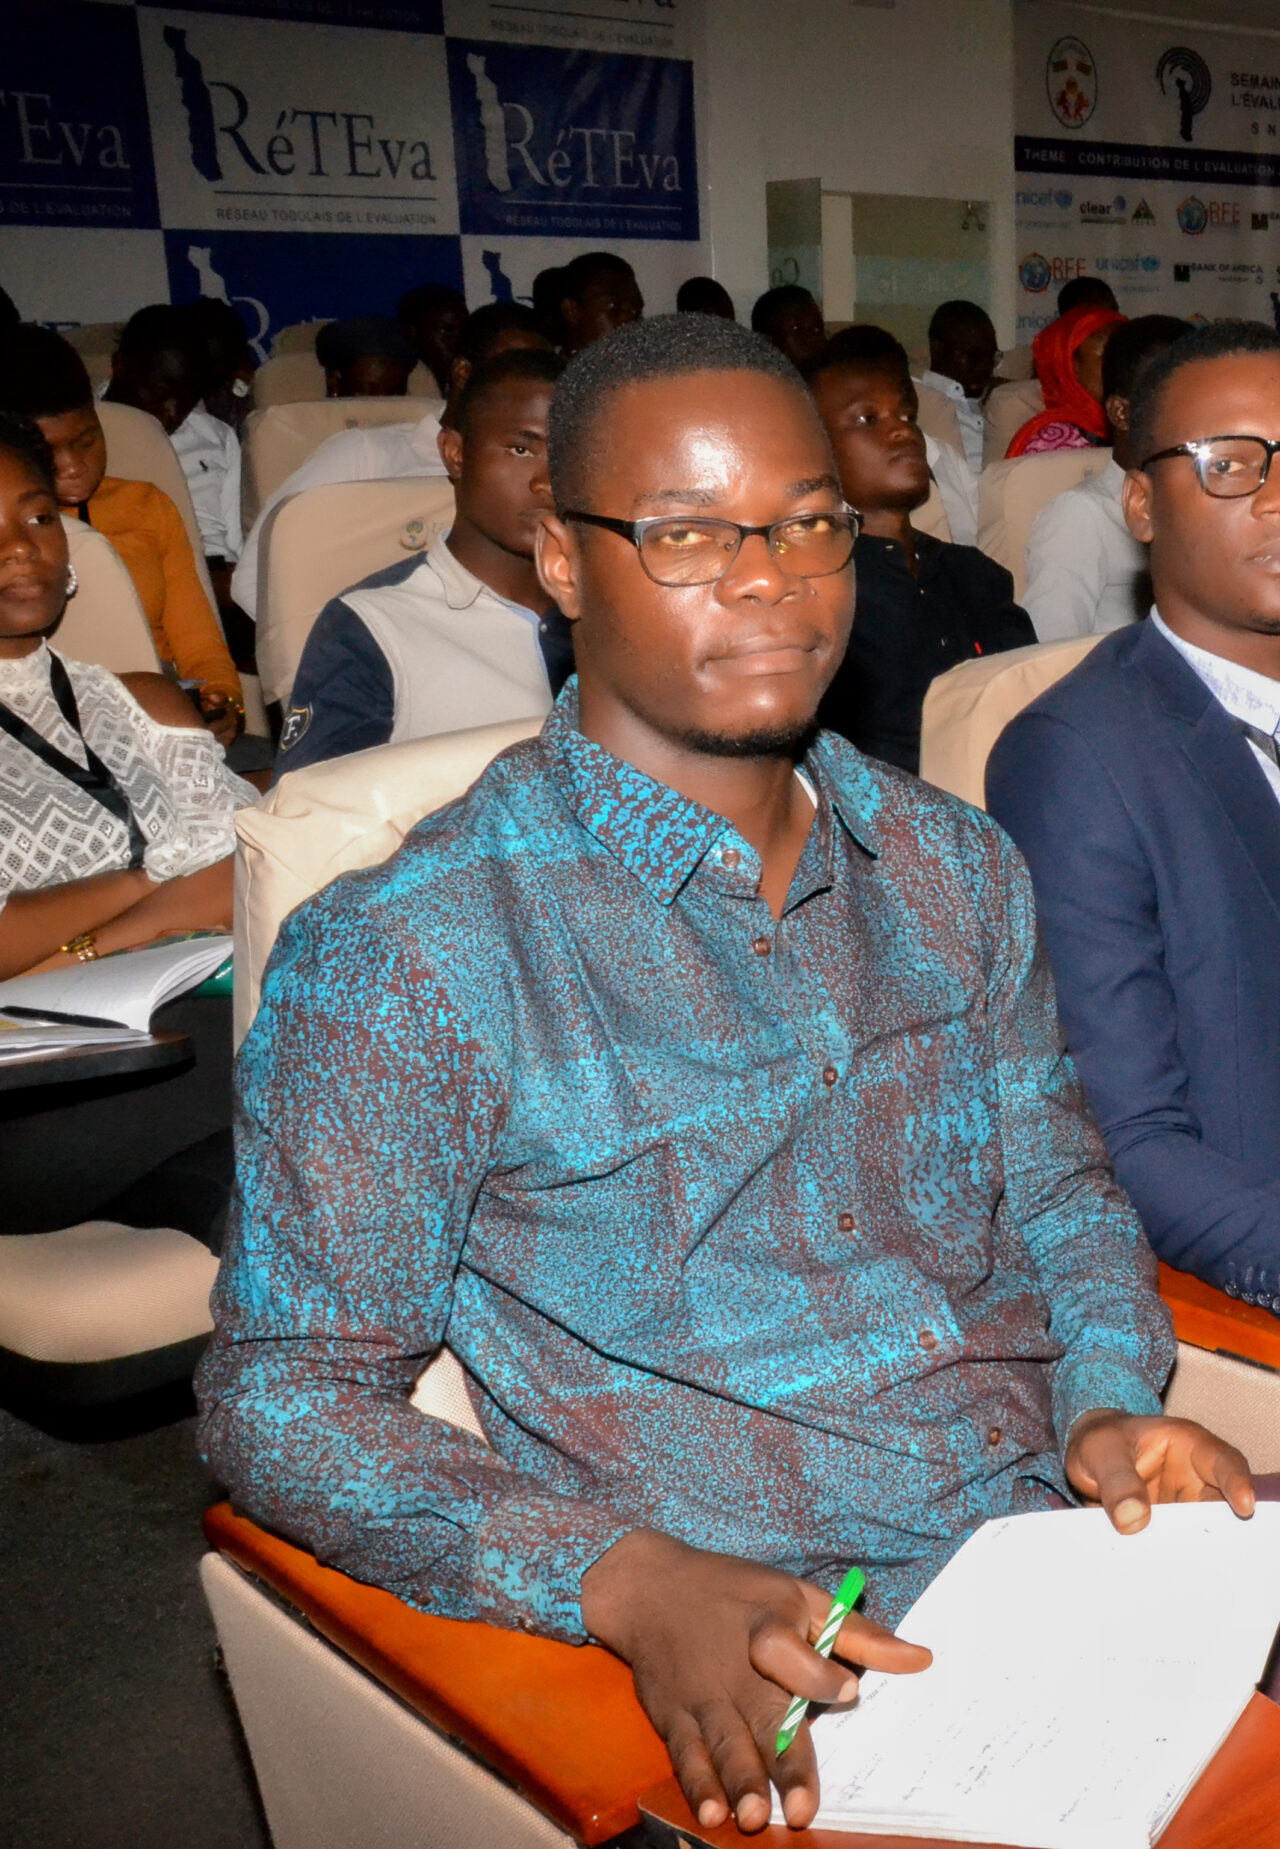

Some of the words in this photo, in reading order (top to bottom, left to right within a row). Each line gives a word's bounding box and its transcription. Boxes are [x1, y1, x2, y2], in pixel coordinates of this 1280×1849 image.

[0, 87, 131, 170] Eva
[206, 80, 438, 182] RéTEva
[502, 101, 683, 193] RéTEva
[1078, 152, 1171, 169] CONTRIBUTION
[1173, 156, 1190, 171] DE
[337, 211, 352, 223] DE
[1079, 200, 1112, 215] clear
